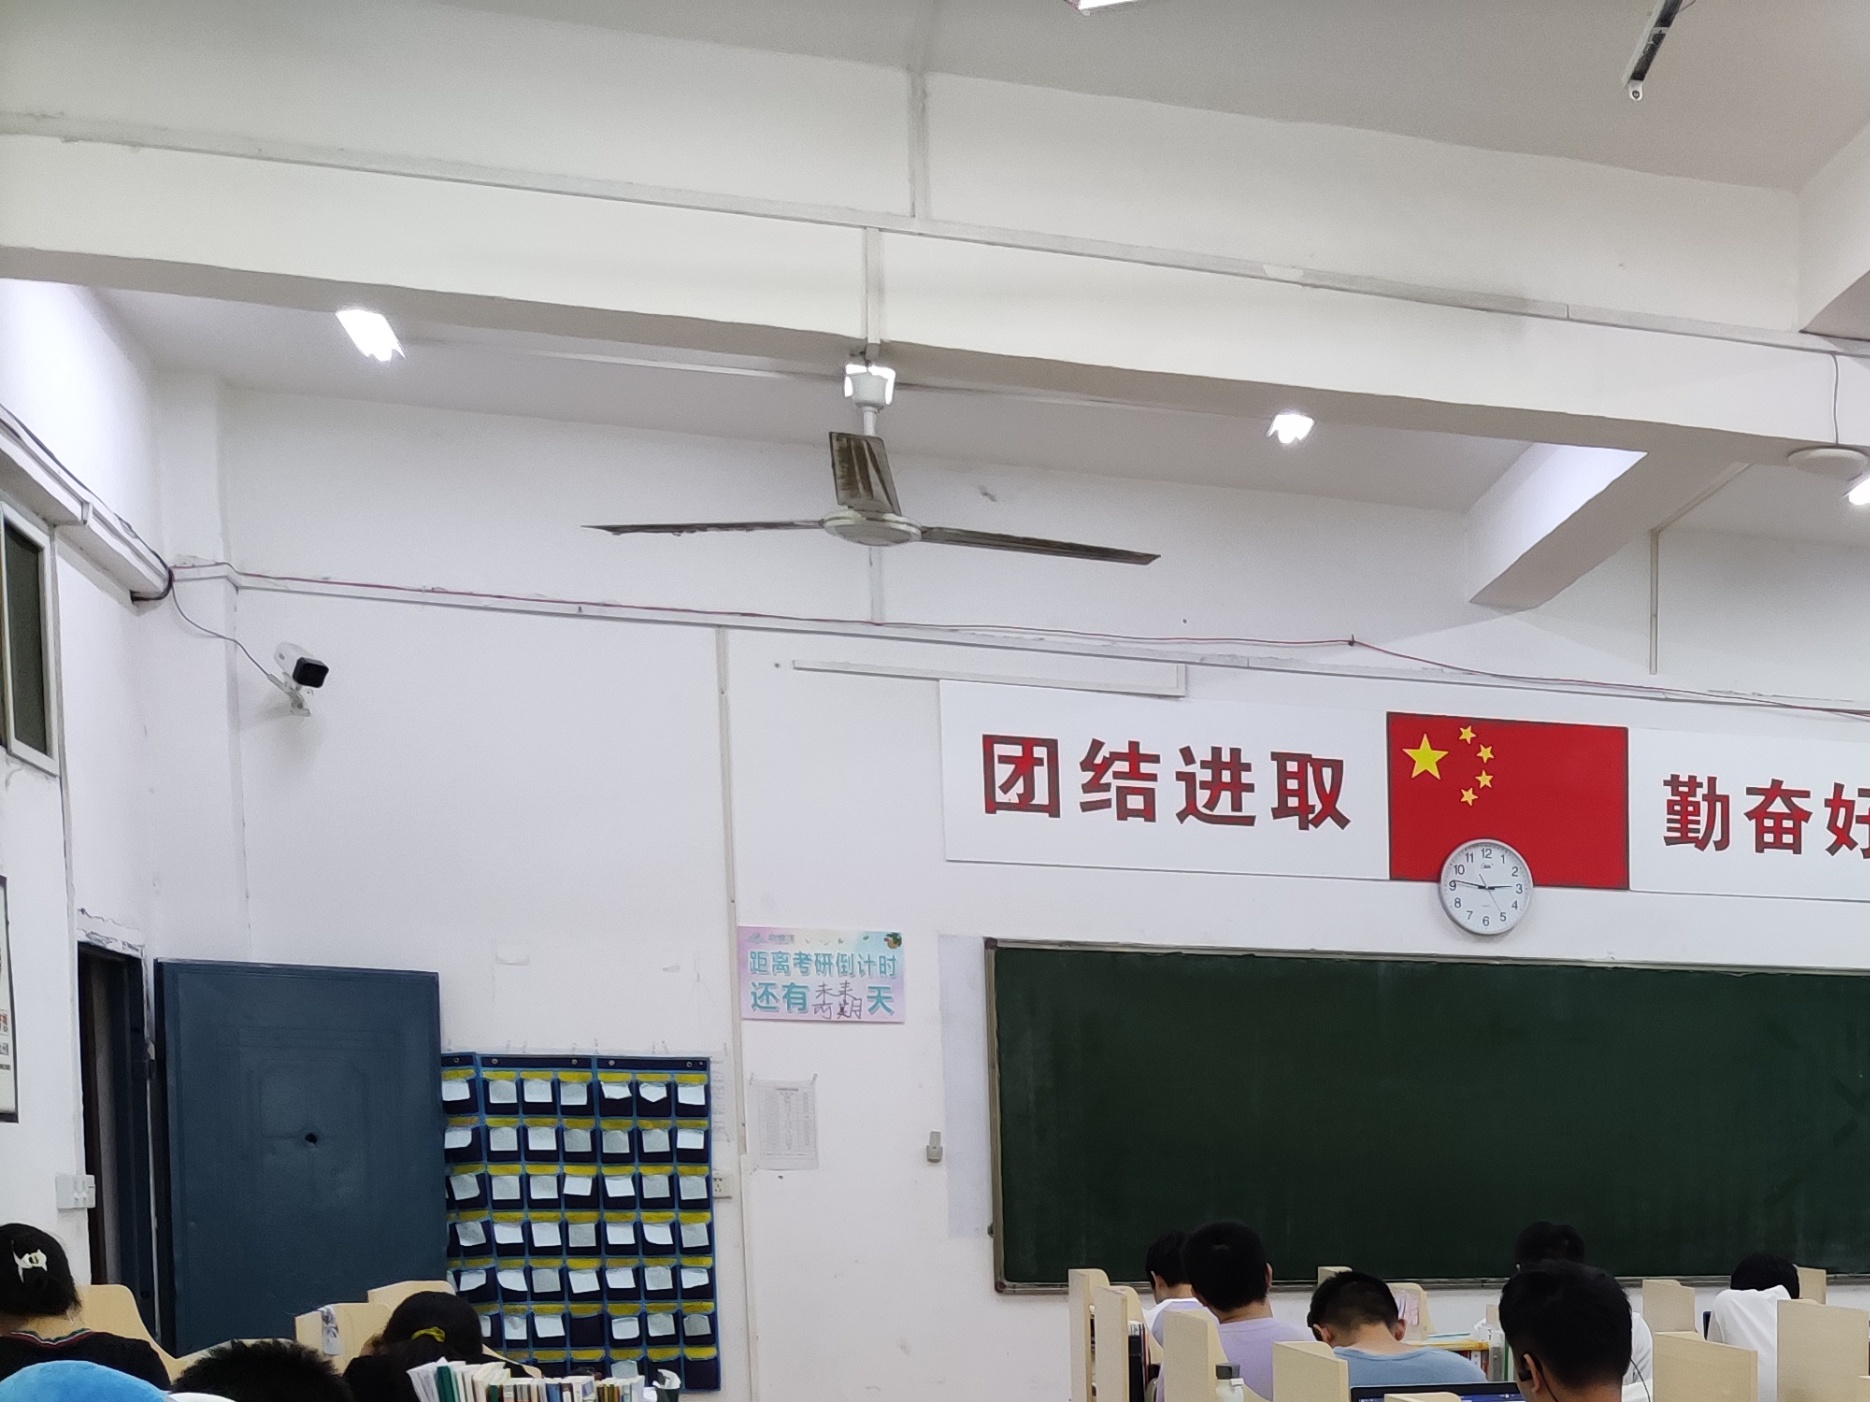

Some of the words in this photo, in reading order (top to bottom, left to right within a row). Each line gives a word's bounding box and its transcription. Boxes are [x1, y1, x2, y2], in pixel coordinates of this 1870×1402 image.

[981, 732, 1350, 831] 团结进取
[1465, 852, 1474, 863] 11
[1481, 848, 1493, 859] 12
[1500, 854, 1505, 864] 1
[1454, 864, 1465, 875] 10
[1511, 866, 1519, 877] 2
[1449, 880, 1456, 891] 9
[1515, 884, 1523, 894] 3
[1454, 897, 1461, 908] 8
[1511, 900, 1518, 910] 4
[1466, 910, 1473, 920] 7
[1482, 915, 1490, 926] 6
[1500, 911, 1506, 922] 5
[749, 950, 897, 979] 距离考研倒计时
[751, 982, 810, 1015] 还有
[867, 985, 896, 1016] 天
